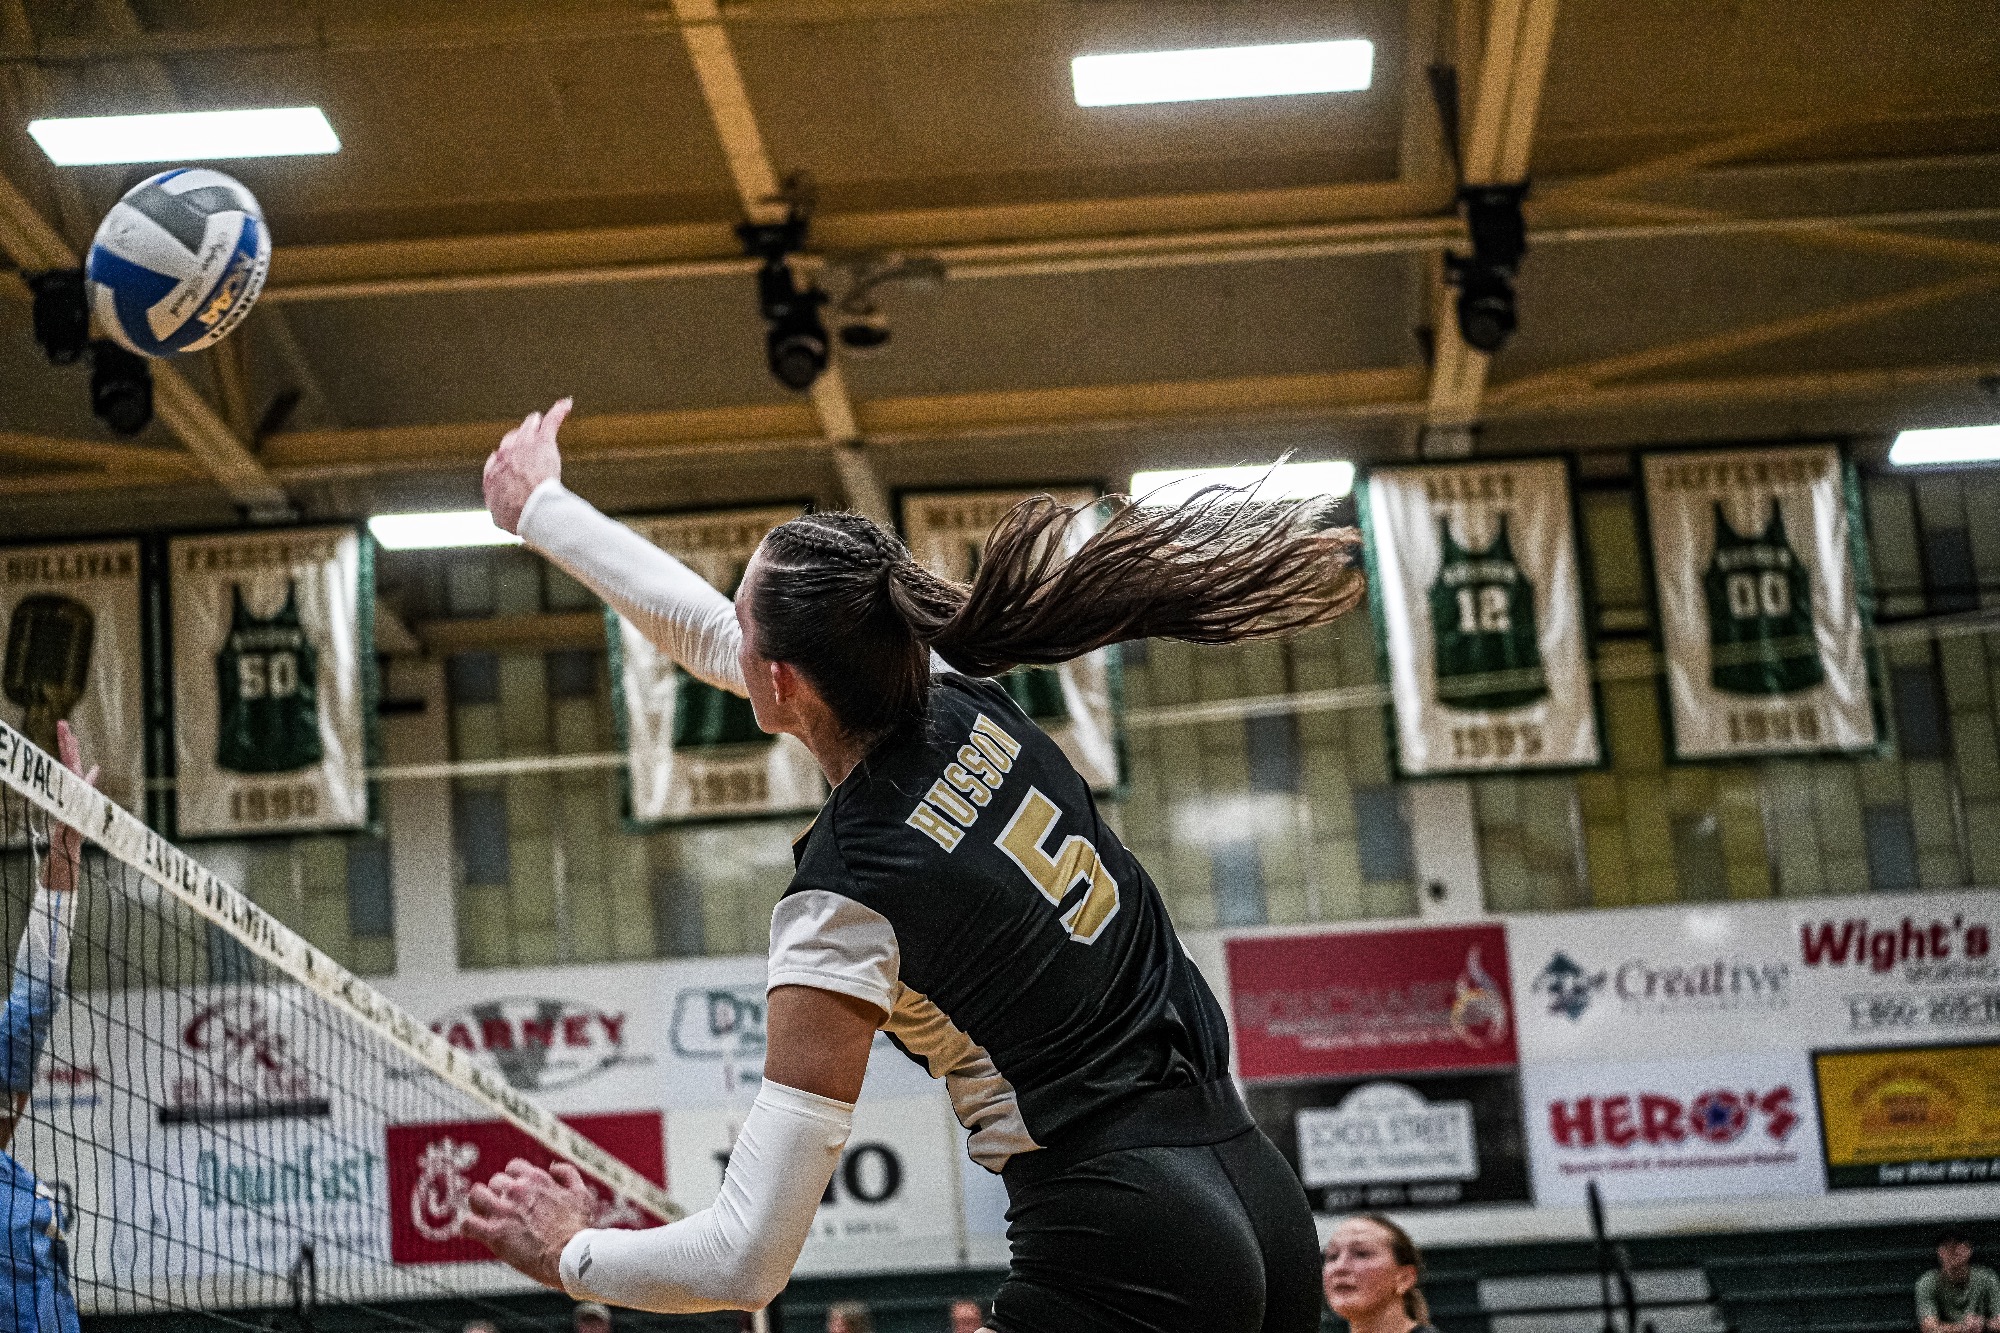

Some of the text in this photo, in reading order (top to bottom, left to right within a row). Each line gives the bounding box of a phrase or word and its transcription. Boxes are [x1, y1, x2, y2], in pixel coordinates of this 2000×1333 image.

[1456, 586, 1511, 633] 12
[1727, 572, 1791, 618] 00
[238, 652, 298, 699] 50
[905, 713, 1022, 853] HUSSON
[994, 785, 1120, 946] 5
[1802, 914, 1990, 972] Wight's
[430, 1010, 625, 1051] ARNEY
[1549, 1084, 1798, 1149] HERO'S
